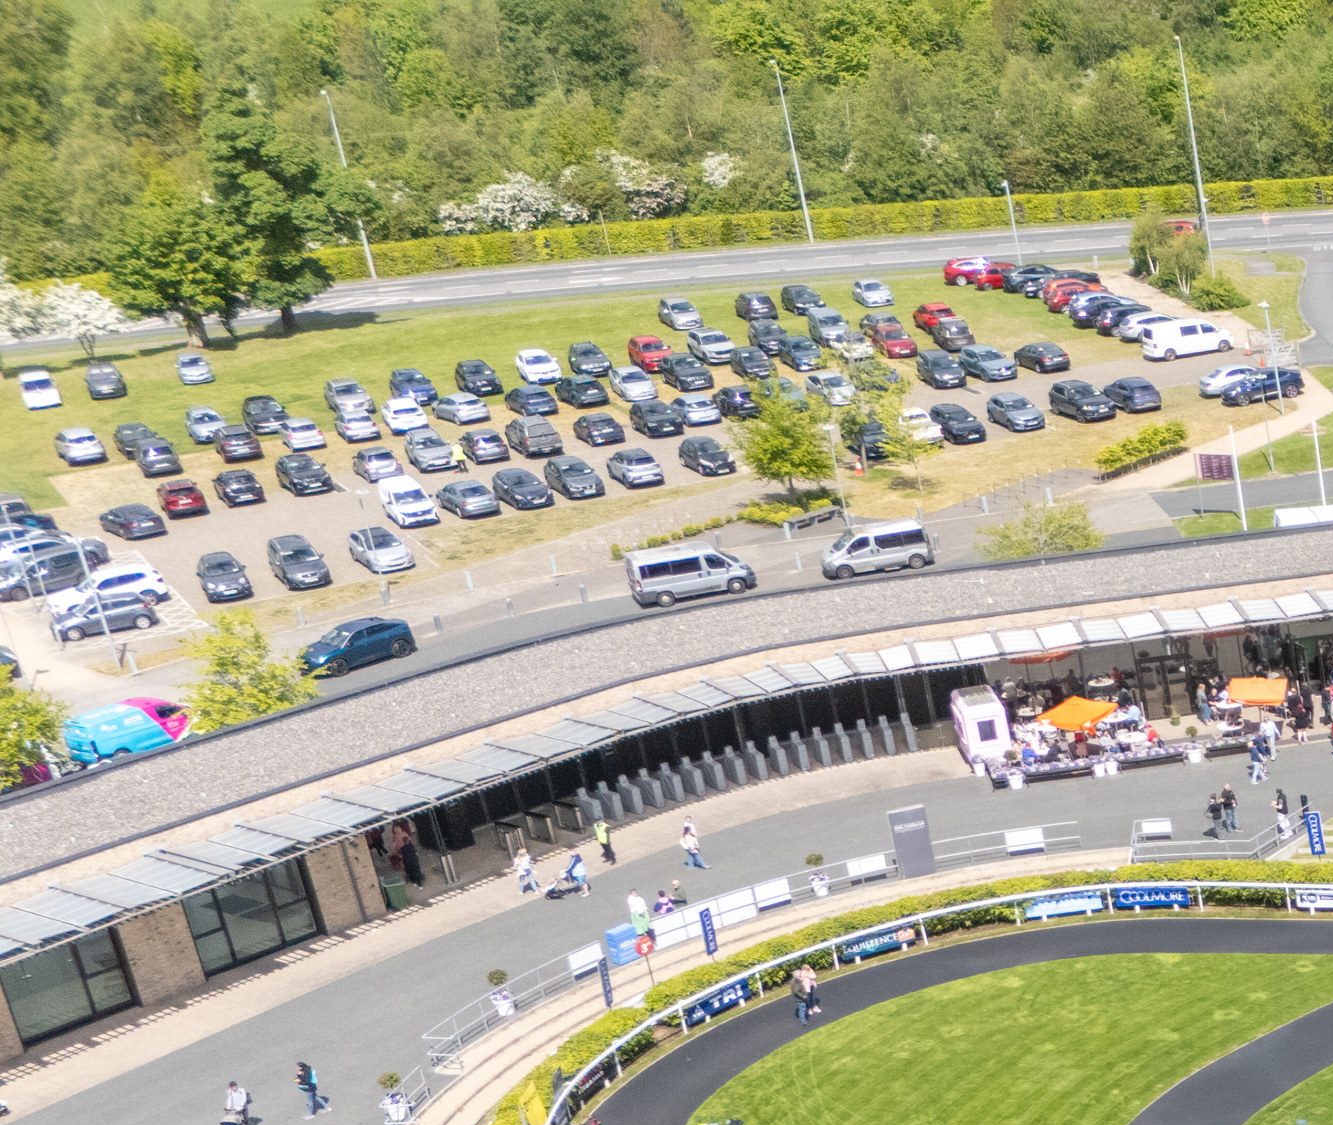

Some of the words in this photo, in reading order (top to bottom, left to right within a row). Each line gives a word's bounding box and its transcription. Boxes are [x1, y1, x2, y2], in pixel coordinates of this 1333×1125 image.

[1308, 814, 1322, 853] COOLMORE
[1119, 890, 1187, 903] COOLMORE
[709, 984, 744, 1009] TRI
